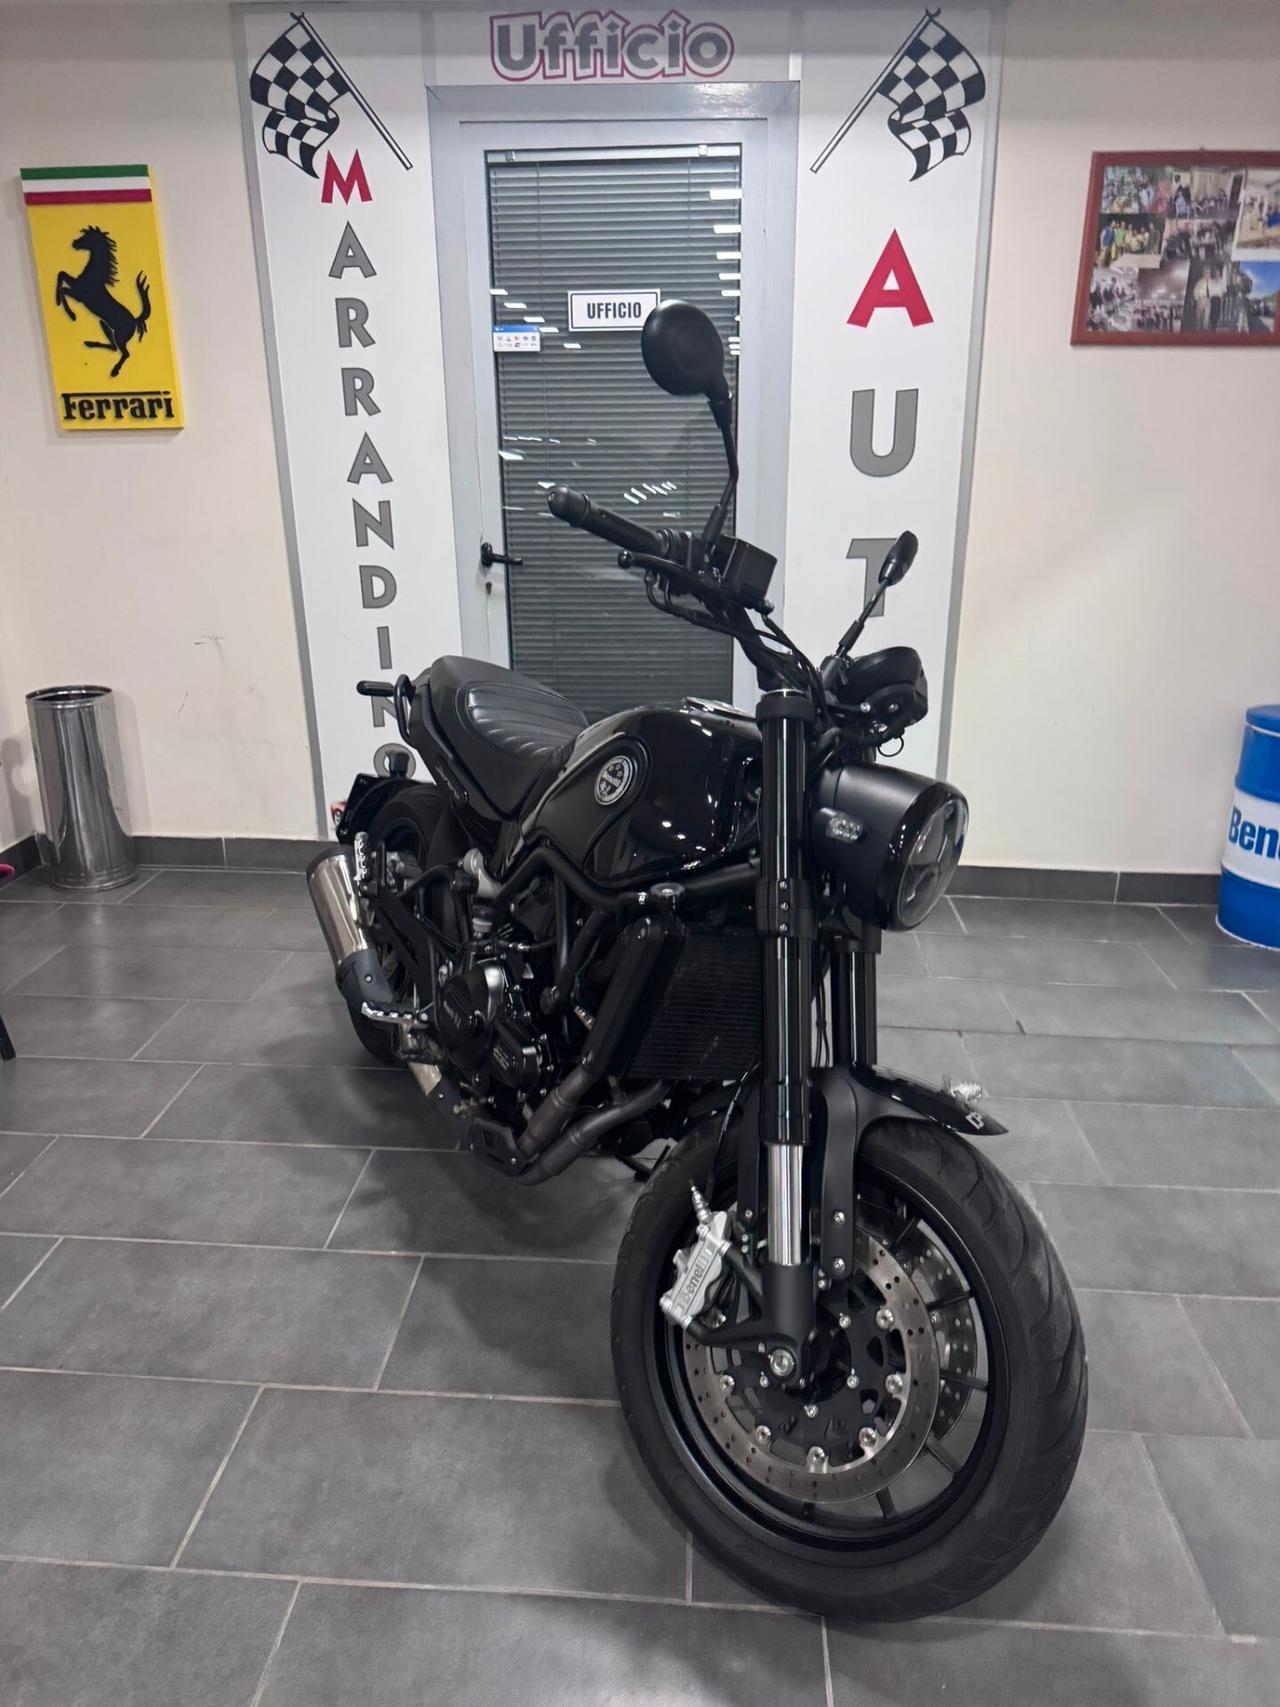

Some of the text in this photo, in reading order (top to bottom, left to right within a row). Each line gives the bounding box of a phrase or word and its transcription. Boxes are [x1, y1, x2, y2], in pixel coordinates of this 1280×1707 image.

[492, 12, 733, 80] Ufficio
[586, 302, 642, 319] UFFICIO
[61, 391, 175, 420] Ferrari
[1228, 804, 1280, 860] Ben
